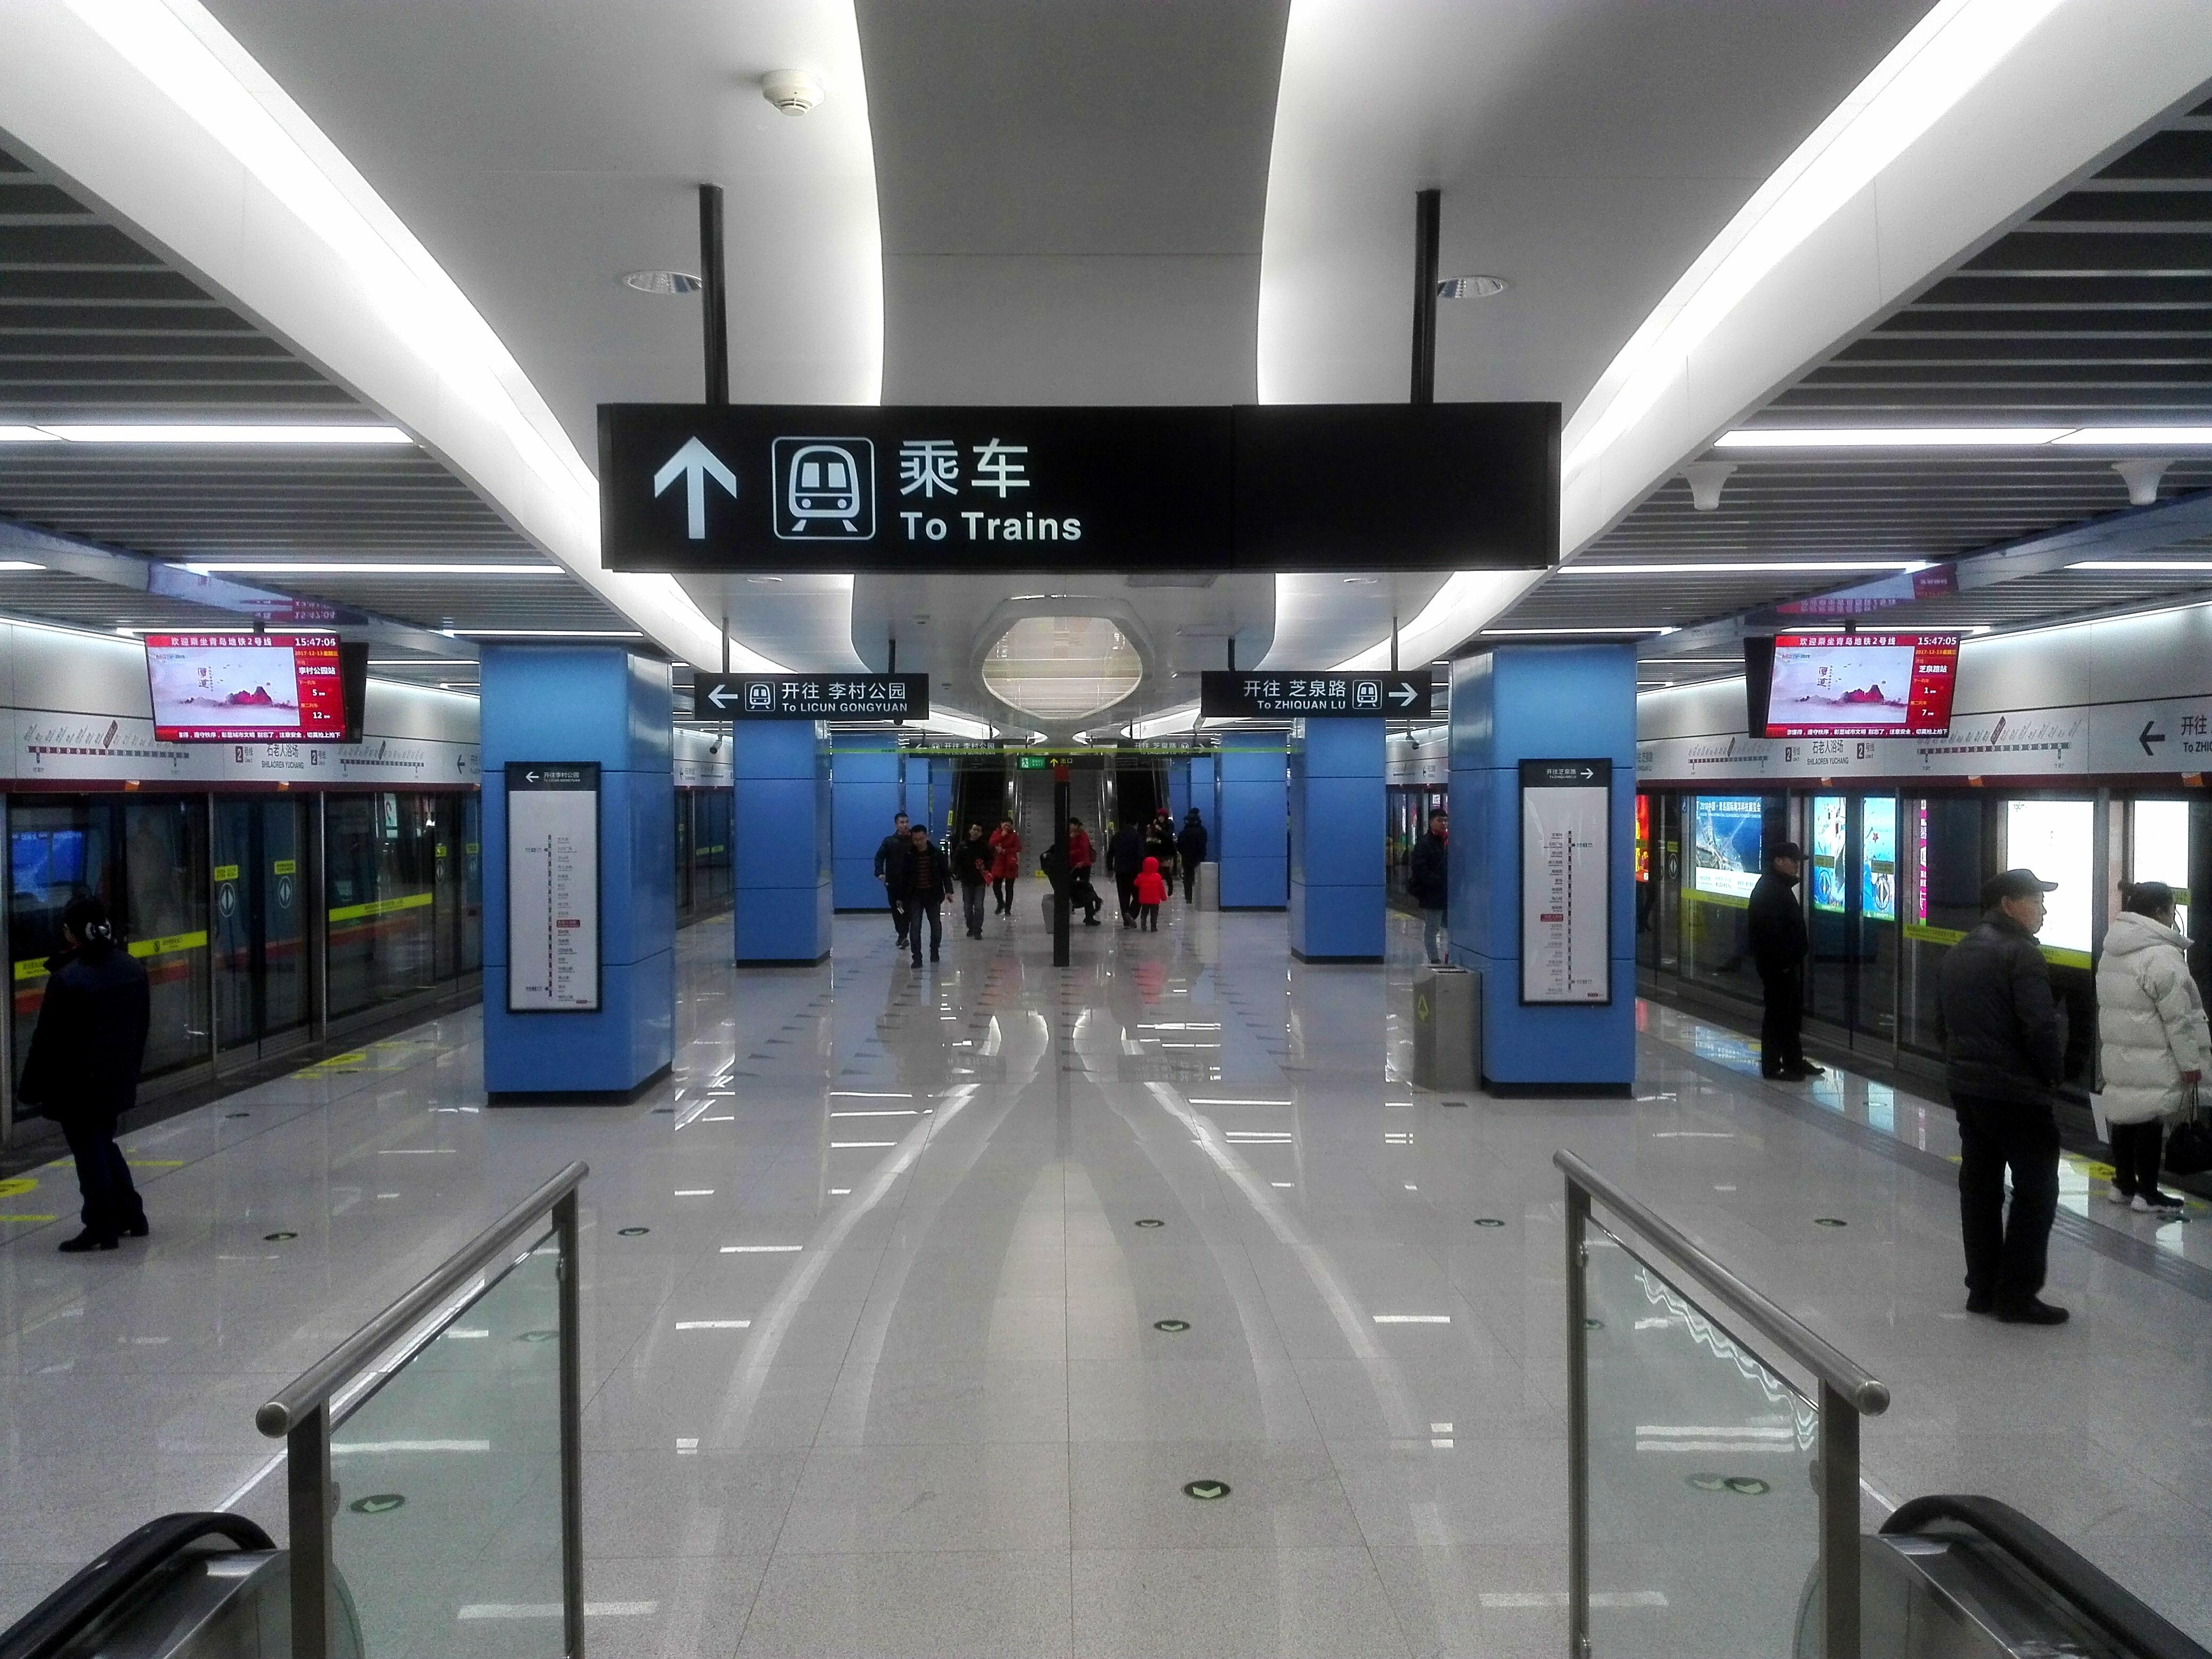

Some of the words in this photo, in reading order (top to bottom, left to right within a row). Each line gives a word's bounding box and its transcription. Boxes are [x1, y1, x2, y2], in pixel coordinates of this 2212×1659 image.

[900, 438, 1031, 499] 乘车
[900, 512, 947, 541] To
[961, 512, 1082, 541] Trains
[171, 637, 272, 646] 欢迎乘坐青岛地铁2号线
[1799, 637, 1896, 646] 欢迎乘坐青岛地铁2号线
[298, 666, 336, 675] 李村公园站
[782, 683, 820, 700] 开往
[828, 683, 906, 700] 李村公园
[1244, 680, 1281, 698] 开往
[1289, 680, 1346, 698] 芝泉路
[782, 703, 797, 712] To
[801, 703, 836, 712] LICUN
[840, 703, 908, 712] GONGYUAN
[1258, 701, 1271, 710] To
[1276, 701, 1328, 710] ZHIQUAN
[1331, 701, 1346, 710] LU
[2181, 715, 2207, 736] 开往
[266, 744, 298, 758] 石老人浴场
[1812, 740, 1844, 753] 石老人浴场
[2183, 742, 2193, 752] To
